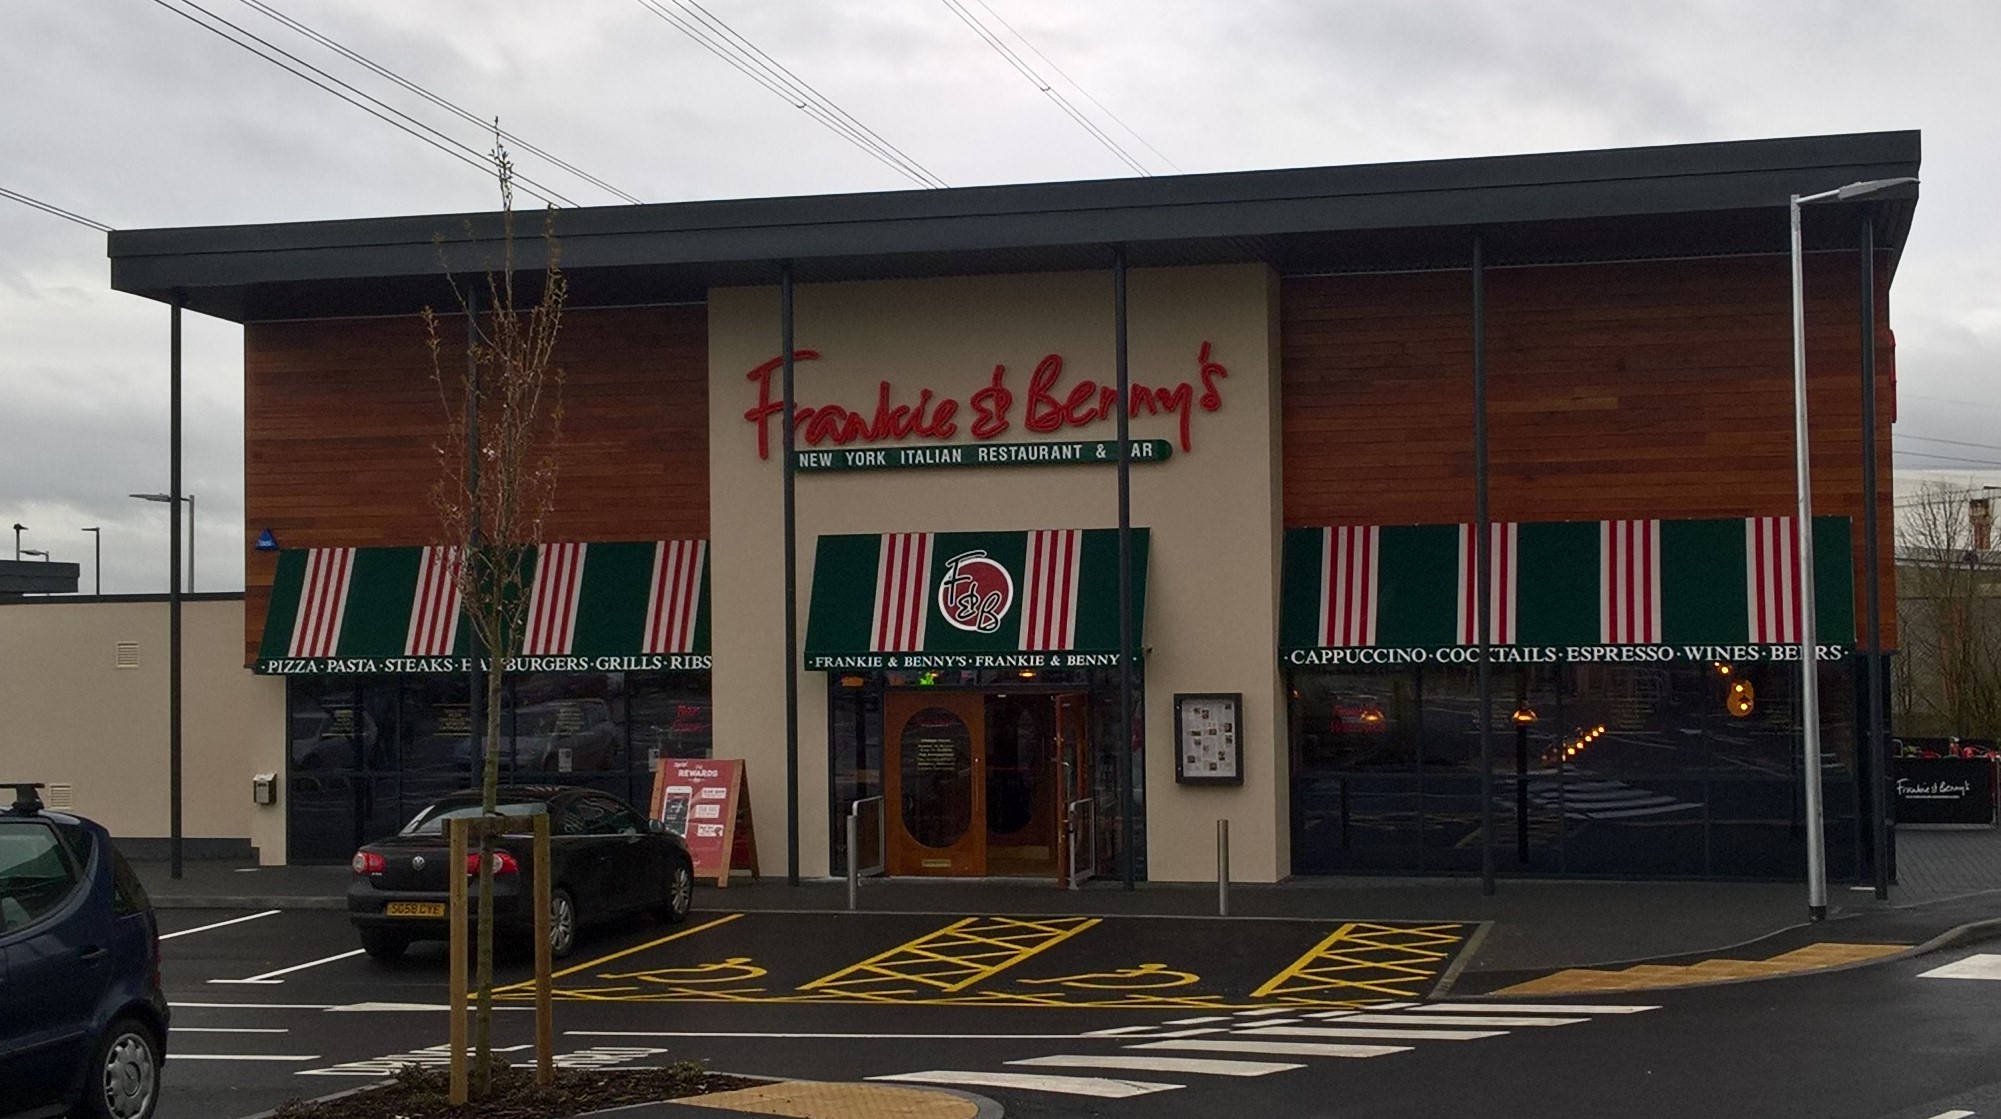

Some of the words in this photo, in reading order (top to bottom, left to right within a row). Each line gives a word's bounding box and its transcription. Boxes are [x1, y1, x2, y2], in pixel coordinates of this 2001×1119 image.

[744, 350, 958, 460] Frankie
[1024, 341, 1228, 452] Benny's
[799, 452, 833, 467] NEW
[845, 451, 887, 465] YORK
[900, 448, 962, 464] ITALIAN
[978, 444, 1083, 461] RESTAURANT
[1095, 443, 1106, 458] &
[1130, 442, 1153, 457] AR
[814, 656, 882, 668] FRANKIE
[888, 656, 898, 667] &
[904, 655, 967, 667] BENNY'S
[975, 655, 1044, 666] FRANKIE
[1050, 655, 1060, 666] &
[1066, 653, 1121, 666] BENNY
[1291, 647, 1427, 664] CAPPUCCINO
[1566, 646, 1674, 662] ESPRESSO
[1683, 645, 1759, 661] WINES
[267, 659, 318, 674] PIZZA
[326, 658, 377, 673] PASTA
[385, 658, 453, 672] STEAKS
[461, 656, 589, 671] HABURGERS
[596, 656, 662, 670] GRILLS
[670, 655, 712, 669] RIBS
[678, 769, 719, 778] REWARDS
